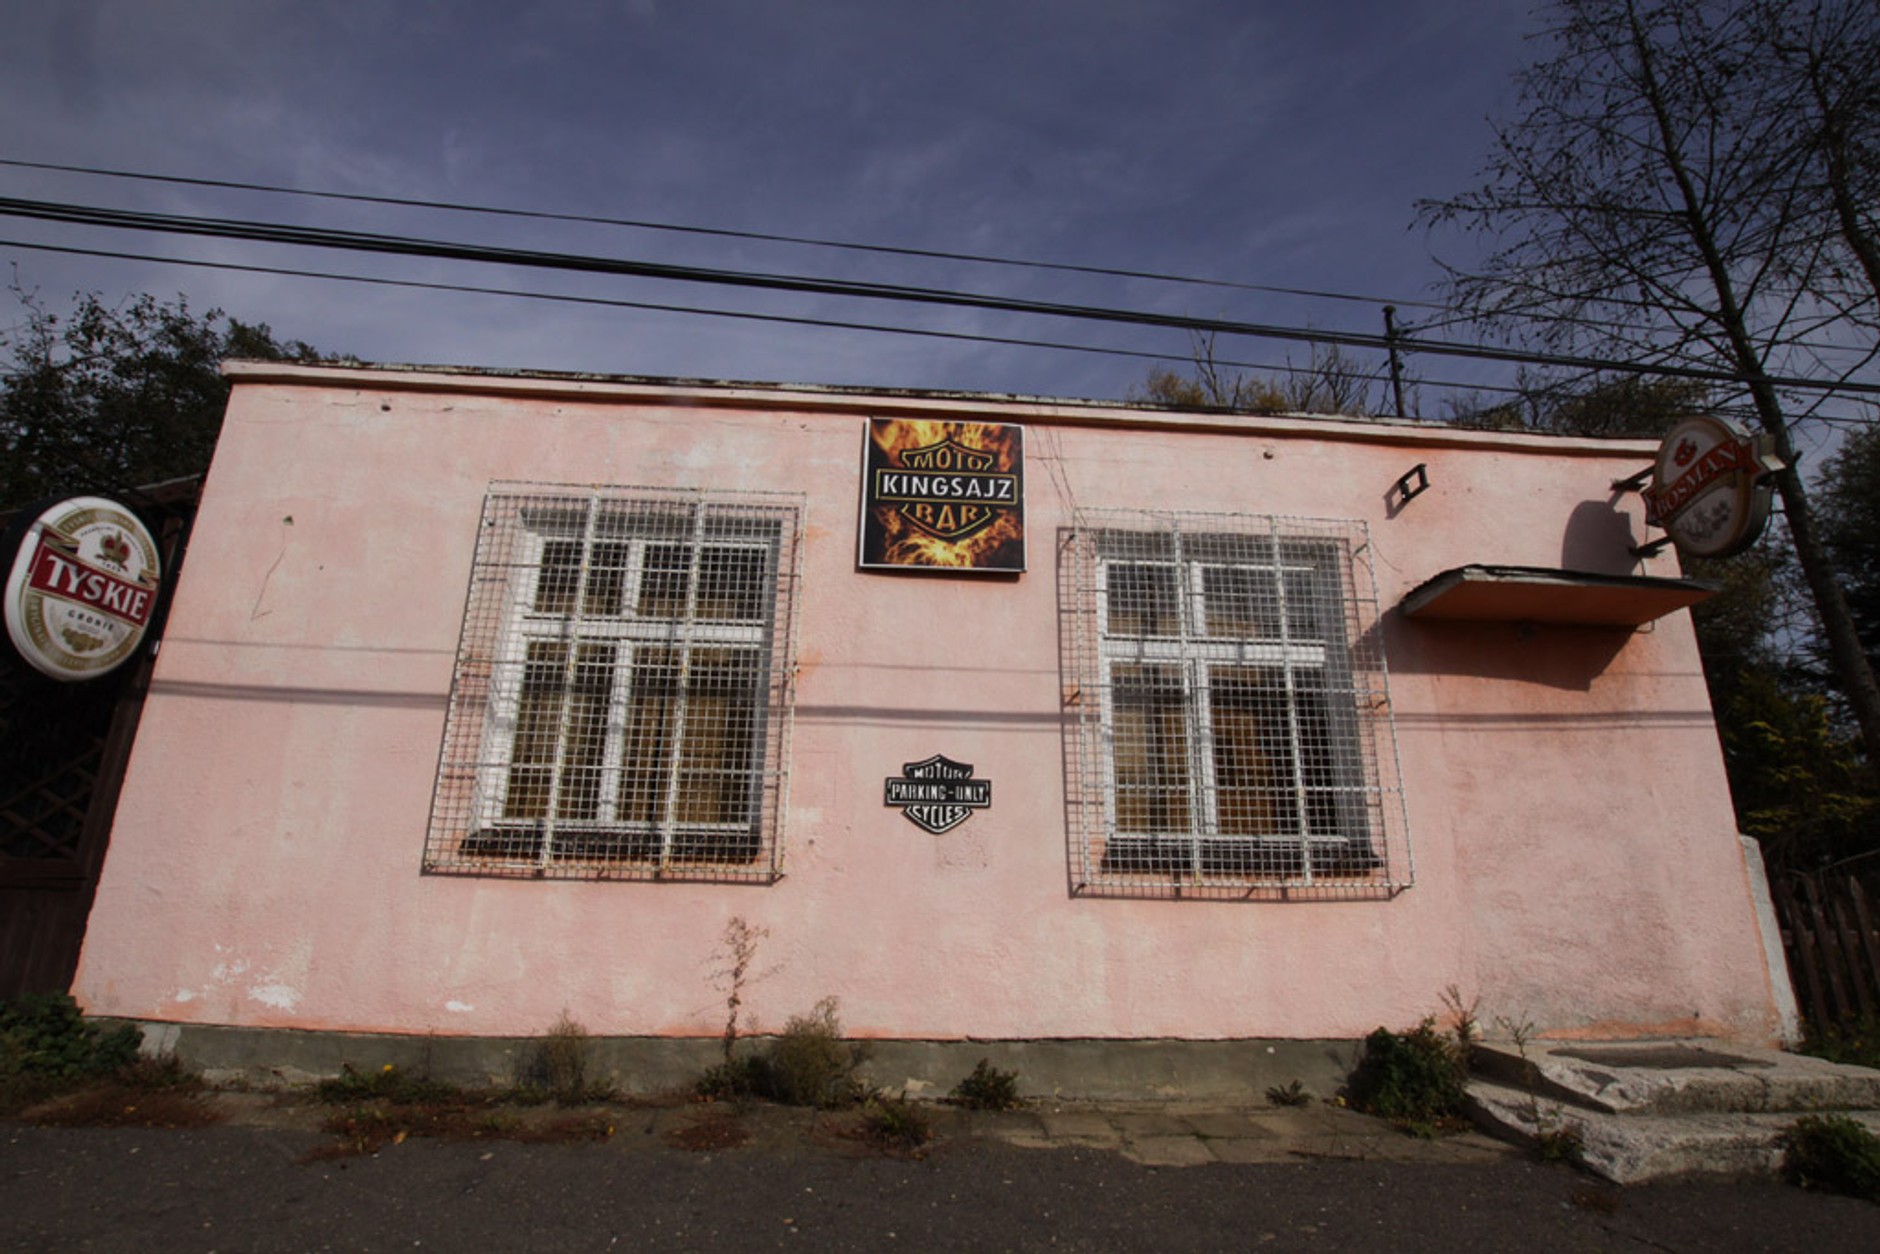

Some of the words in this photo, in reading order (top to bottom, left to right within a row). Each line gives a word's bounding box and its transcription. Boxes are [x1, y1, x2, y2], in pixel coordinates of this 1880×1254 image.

[913, 448, 983, 471] MOTO
[882, 474, 1012, 498] KINGSAJZ
[916, 503, 979, 531] BAR
[47, 555, 148, 620] TYSKIE
[912, 805, 964, 827] CYCLES
